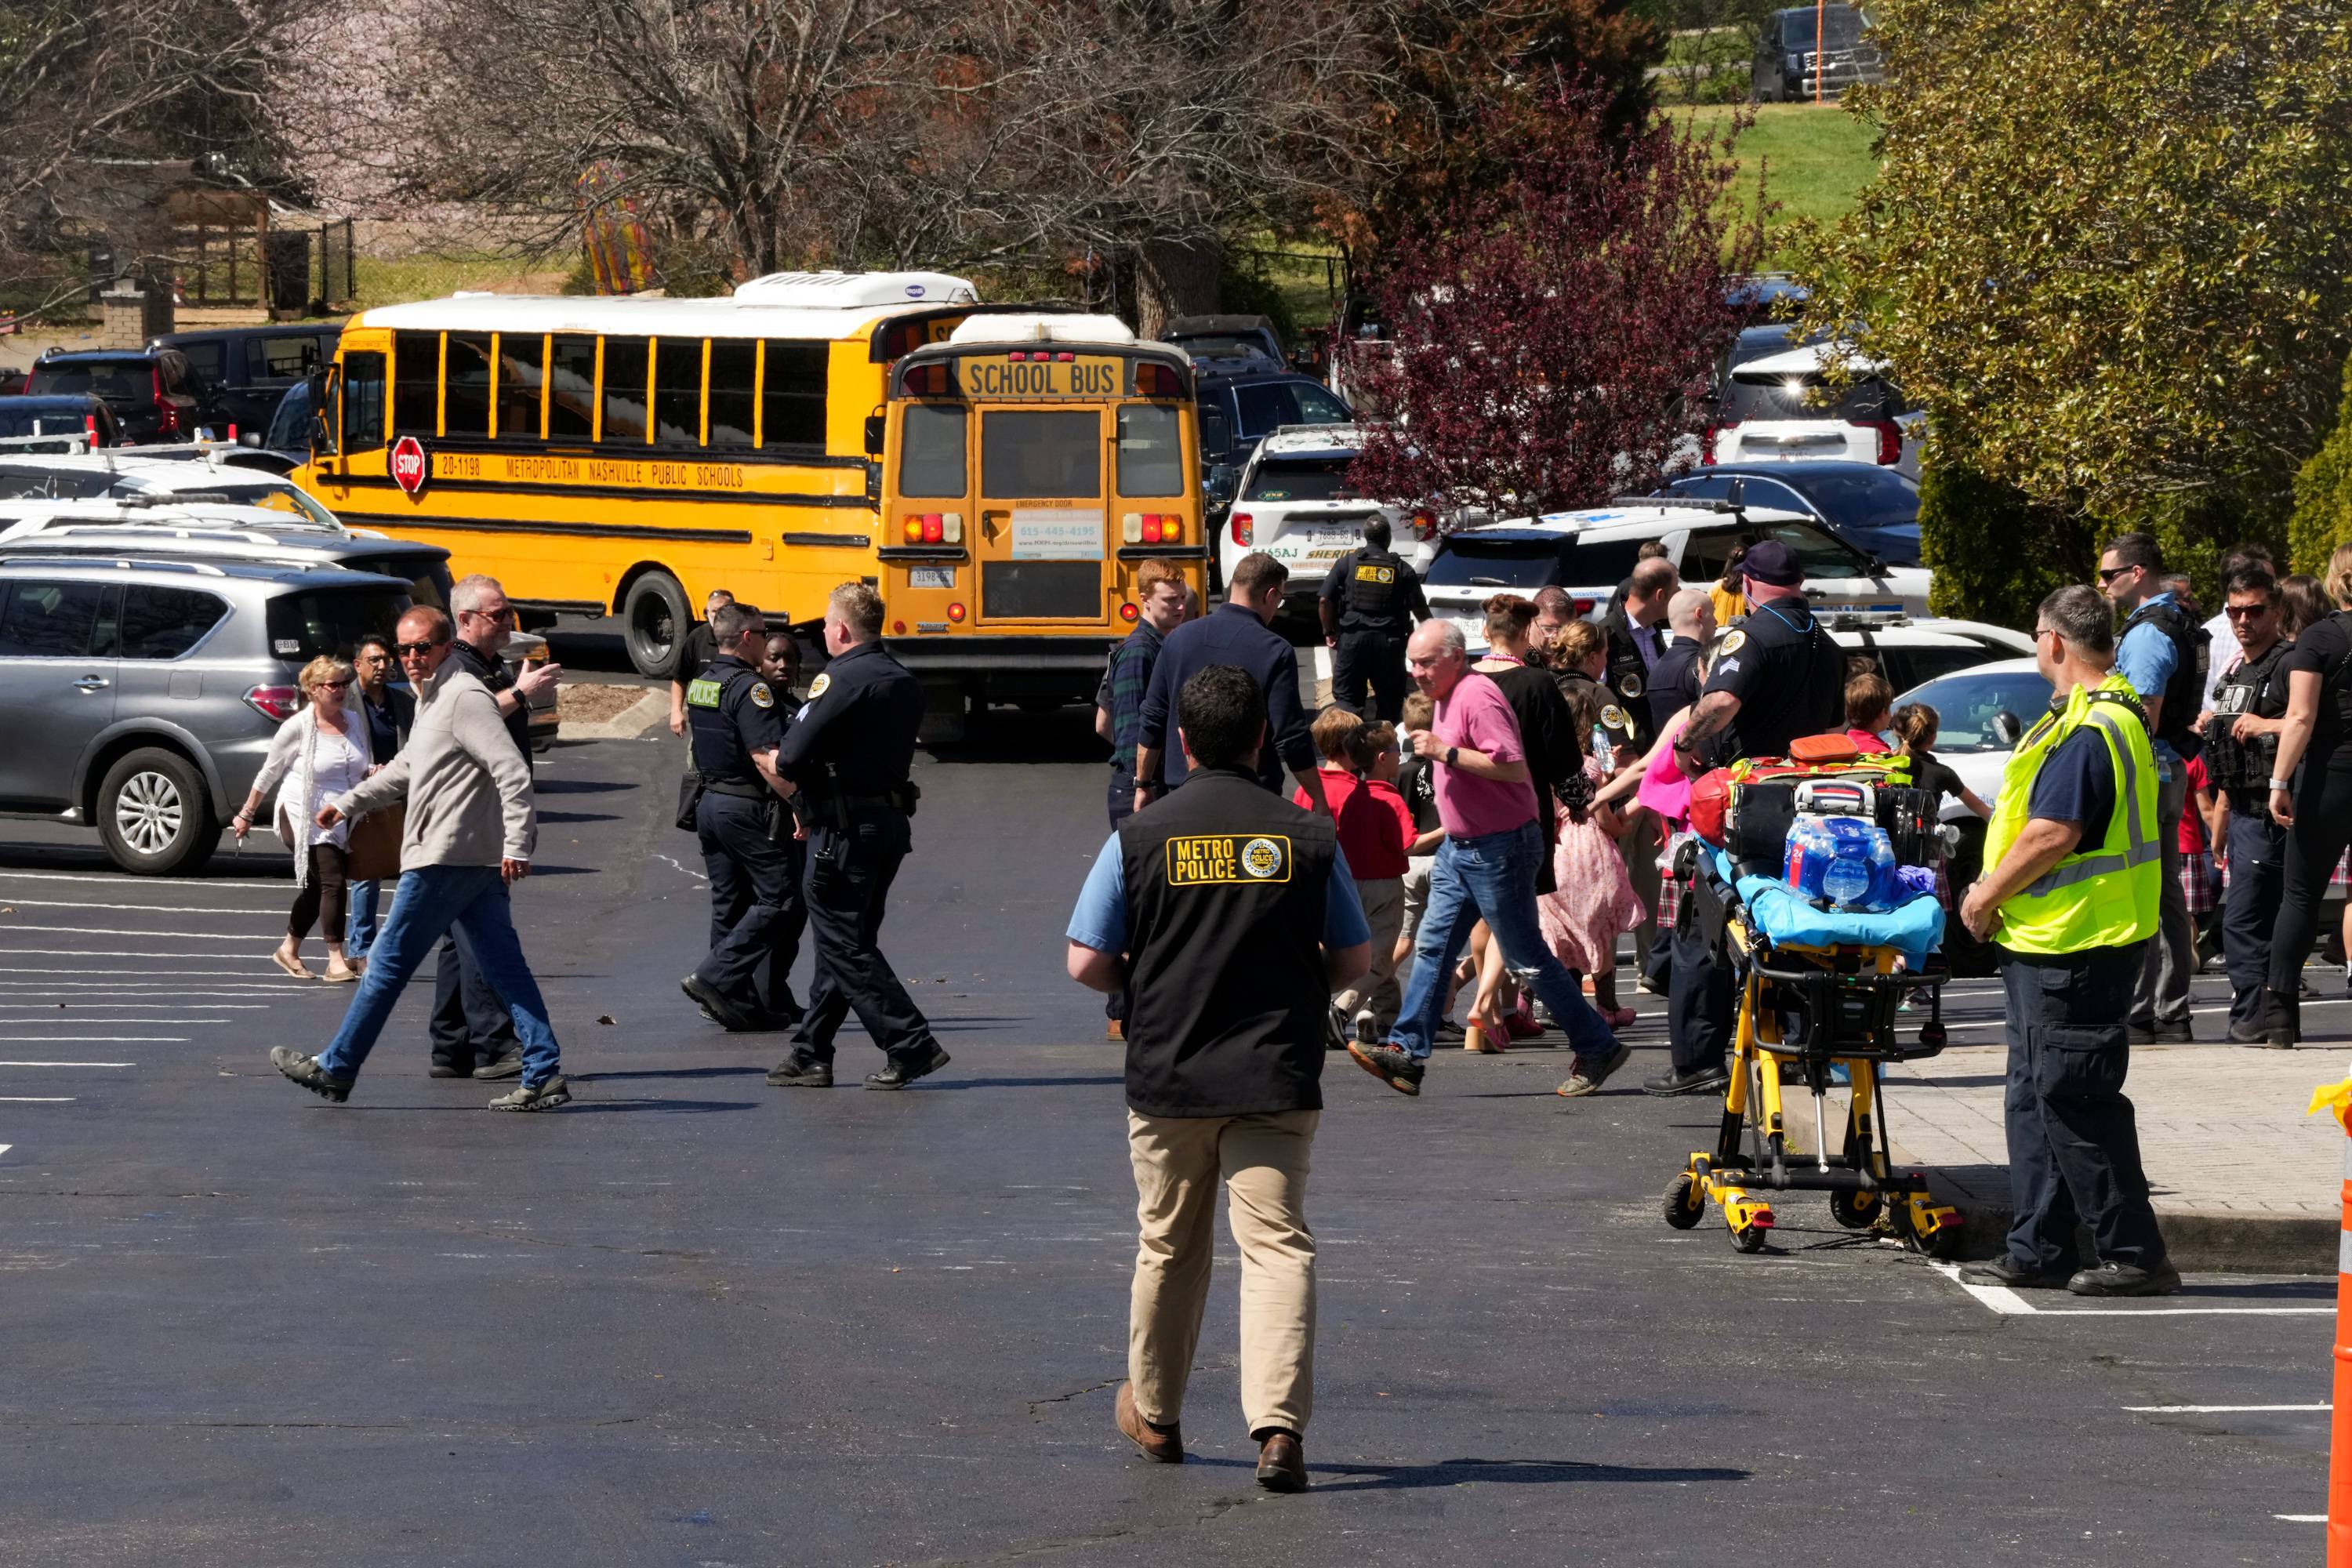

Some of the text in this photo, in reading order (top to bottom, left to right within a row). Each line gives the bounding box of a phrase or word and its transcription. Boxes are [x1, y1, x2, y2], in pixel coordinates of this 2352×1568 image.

[970, 364, 1115, 394] SCHOOL BUS
[397, 454, 421, 475] STOP
[443, 456, 743, 488] 20-1198 METROPOLITAN NASHVILLE PUBLIC SCHOOLS
[1016, 499, 1073, 509] EMERGENCY DOOR
[688, 681, 718, 706] POLICE
[1177, 838, 1234, 861] METRO
[1793, 848, 1803, 859] 24
[1177, 858, 1236, 881] POLICE
